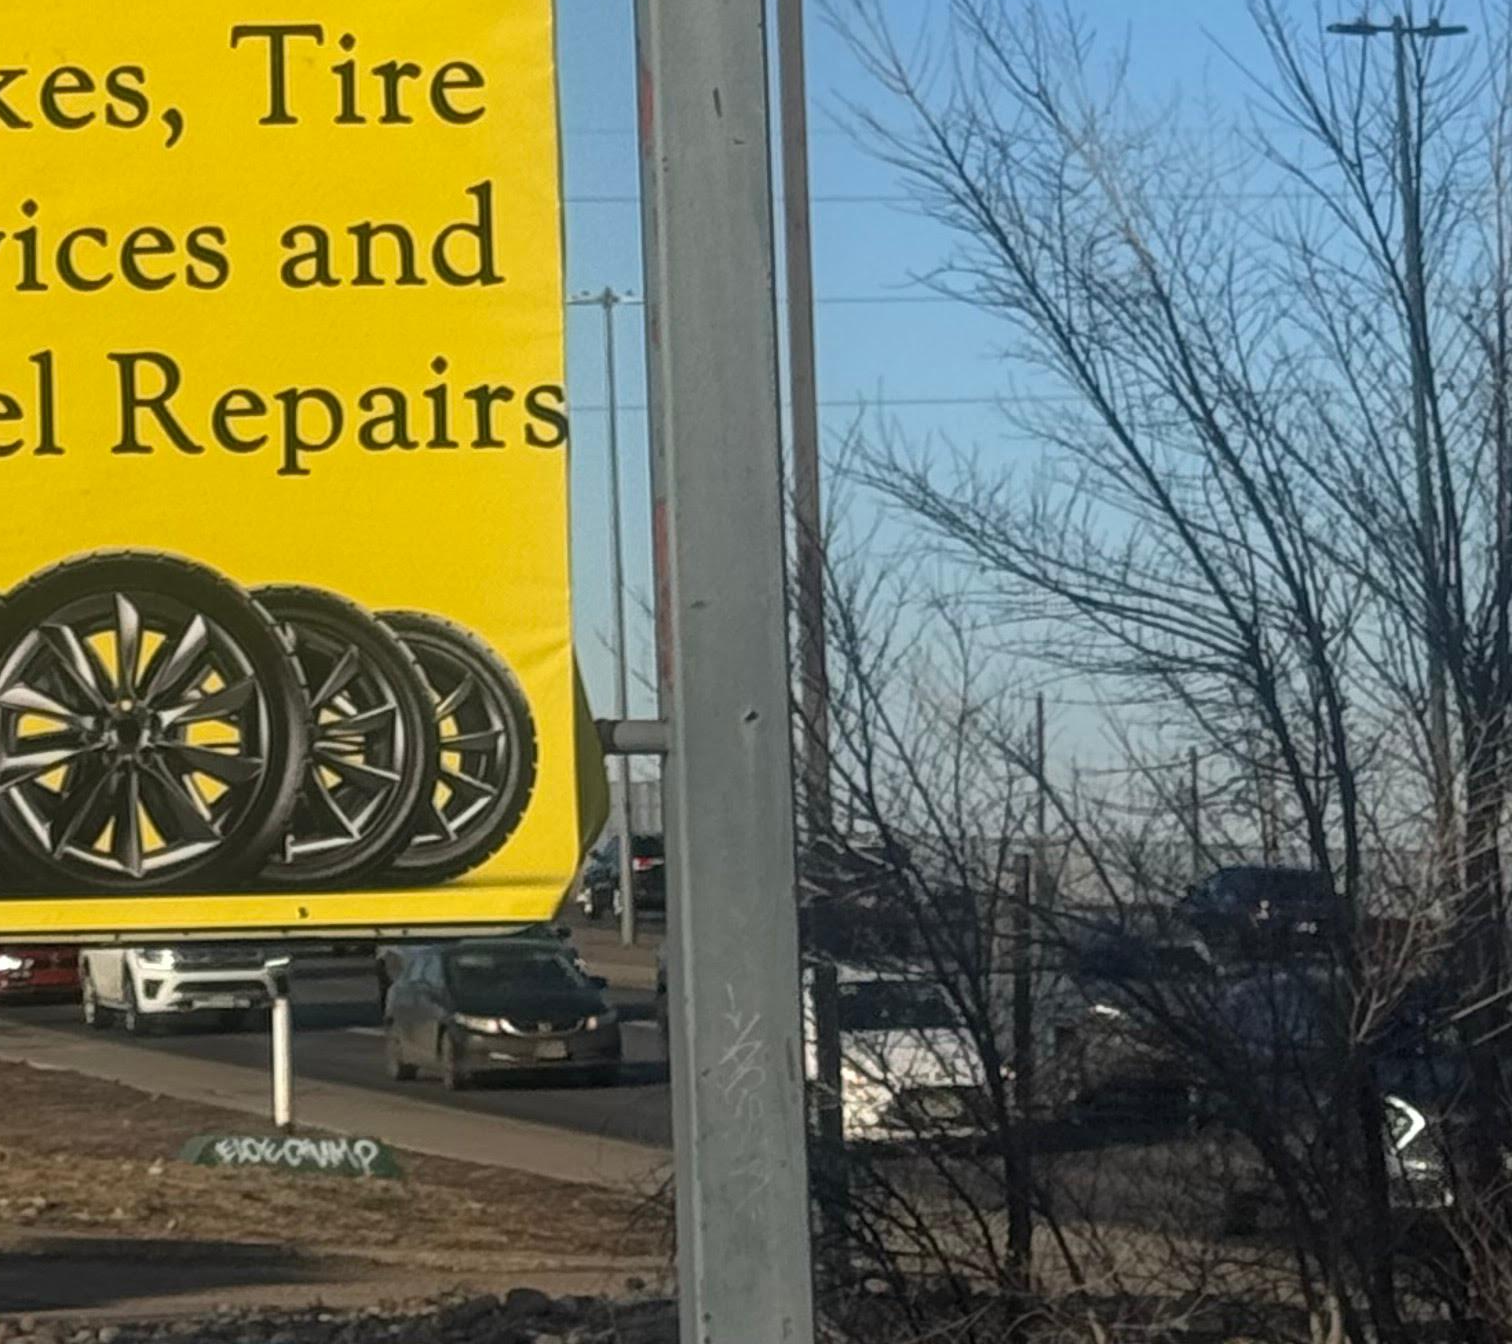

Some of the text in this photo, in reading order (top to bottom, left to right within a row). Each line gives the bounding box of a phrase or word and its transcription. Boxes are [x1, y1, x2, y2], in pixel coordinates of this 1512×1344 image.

[231, 25, 484, 124] Tire
[281, 181, 504, 287] and
[108, 352, 569, 475] Repairs
